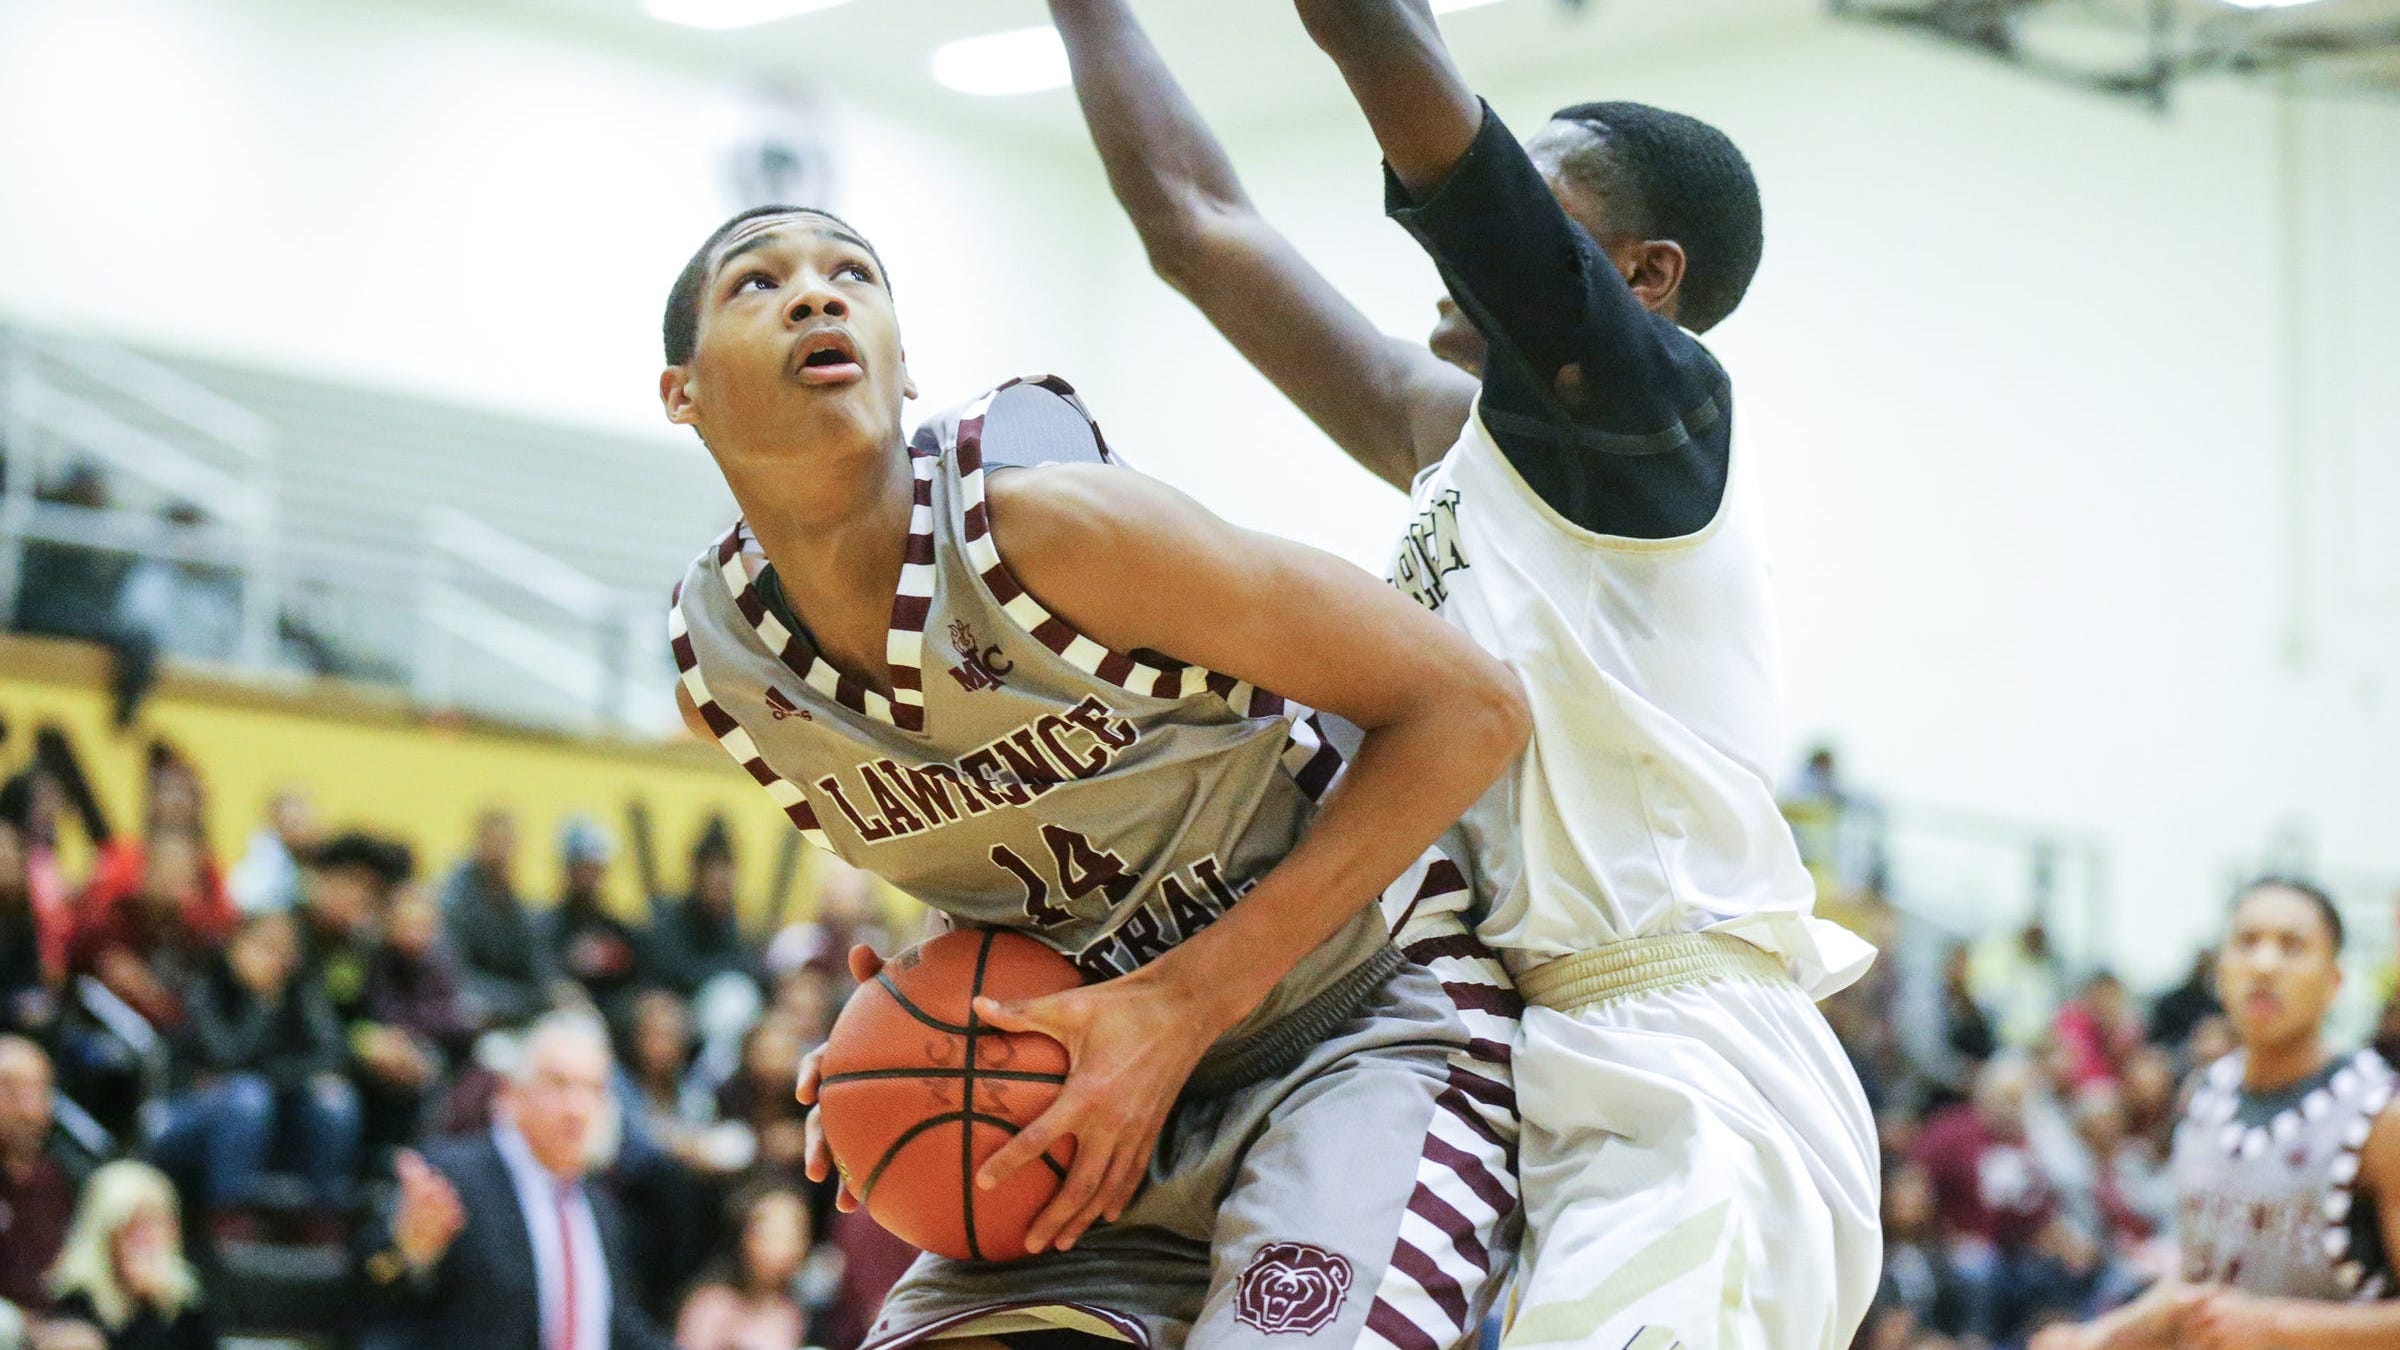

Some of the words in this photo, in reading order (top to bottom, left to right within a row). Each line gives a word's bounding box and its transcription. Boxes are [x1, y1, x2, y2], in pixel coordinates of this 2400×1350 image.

[815, 692, 1140, 845] LAWRENCE
[989, 823, 1143, 930] 14
[1066, 852, 1258, 982] TRAL
